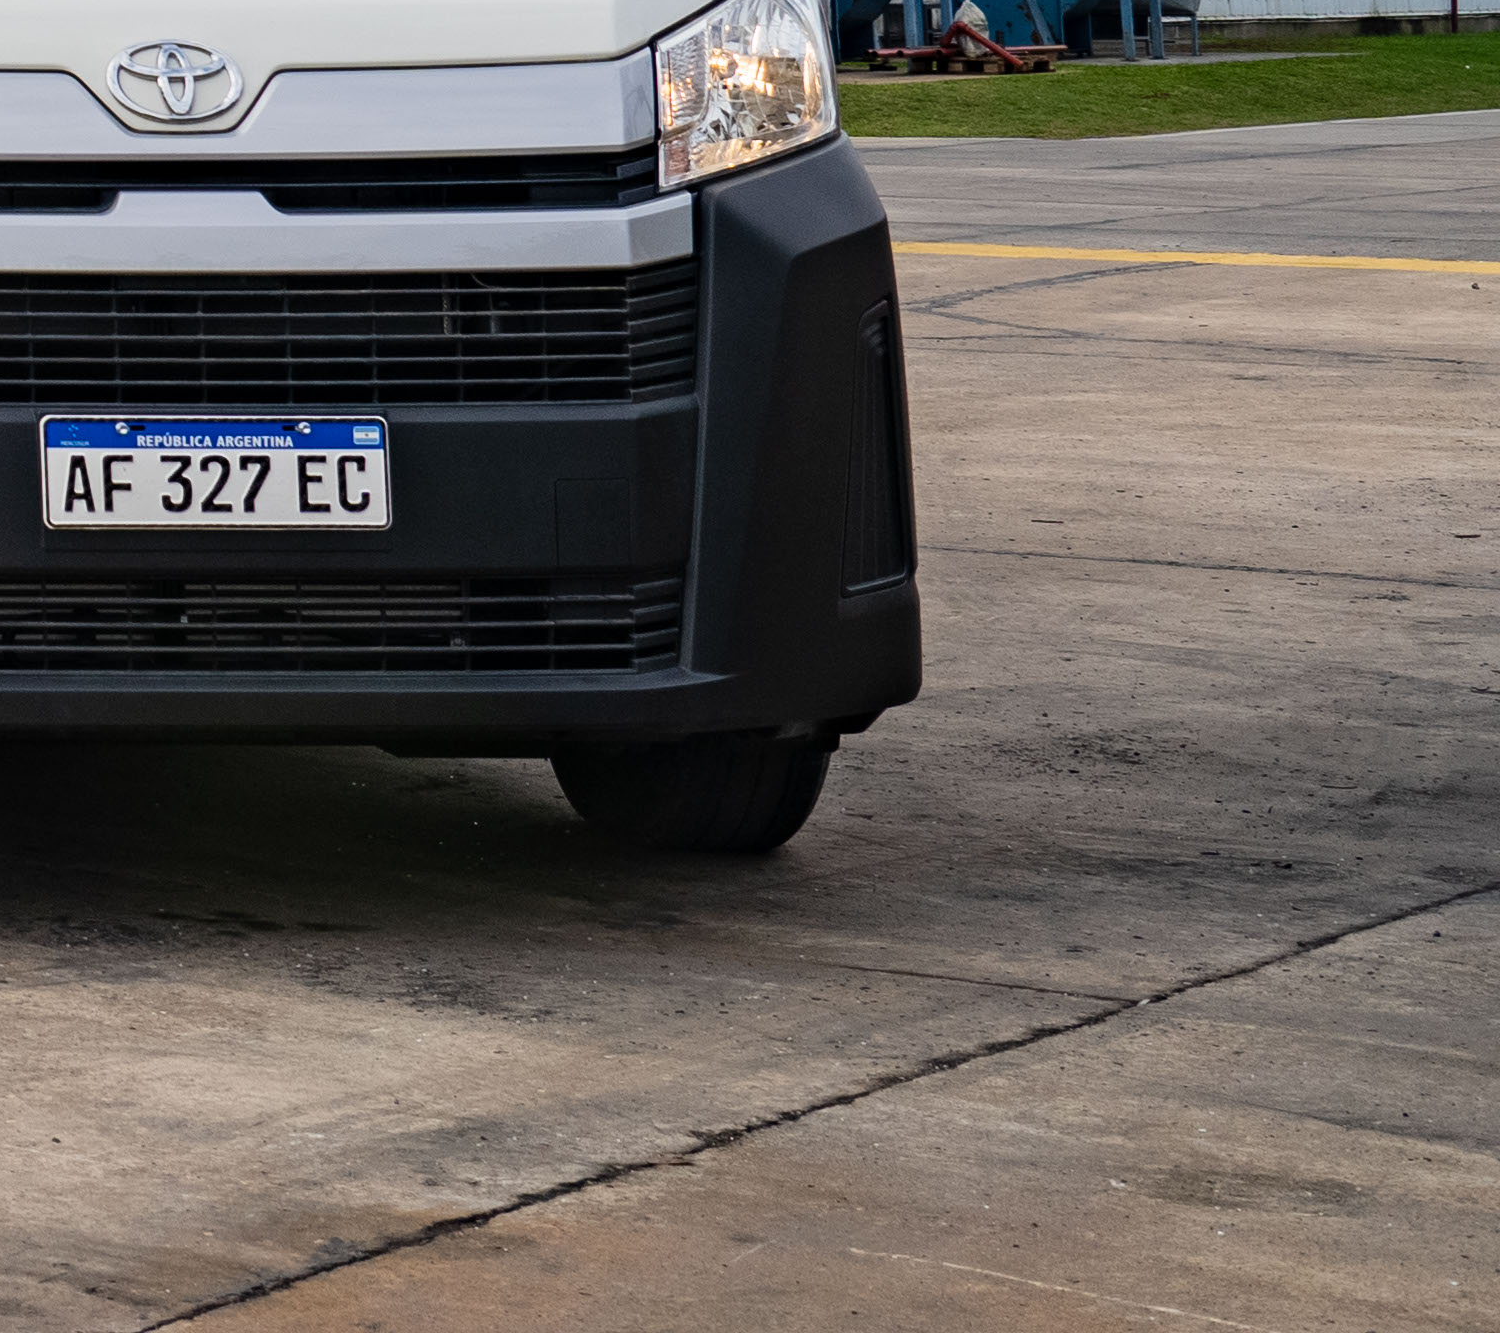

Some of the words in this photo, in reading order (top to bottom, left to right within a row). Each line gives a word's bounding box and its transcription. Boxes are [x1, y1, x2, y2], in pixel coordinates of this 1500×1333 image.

[136, 432, 212, 447] REPÚBLICA
[216, 435, 294, 447] ARGENTINA
[64, 455, 134, 513] AF
[160, 455, 271, 513] 327
[298, 455, 371, 513] EC
